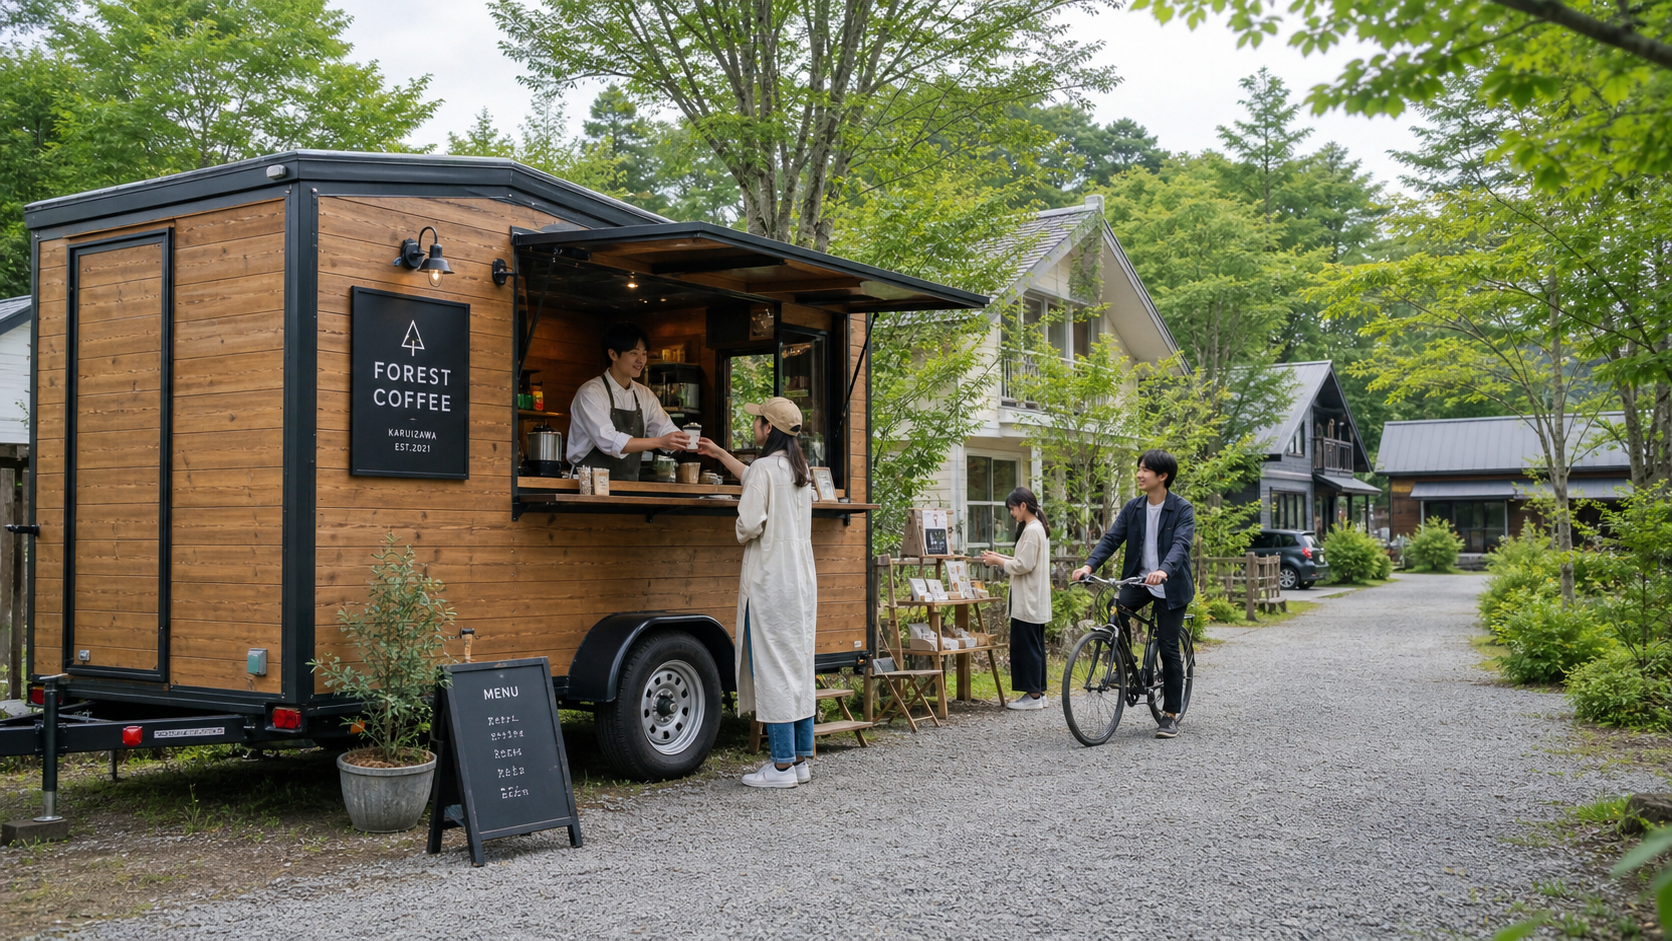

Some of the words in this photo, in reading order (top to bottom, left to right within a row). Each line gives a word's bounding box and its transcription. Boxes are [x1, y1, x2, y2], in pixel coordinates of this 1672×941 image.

[374, 361, 451, 386] FOREST
[373, 388, 451, 412] COFFEE
[388, 428, 437, 440] KARUIZAWA
[483, 685, 519, 700] MENU
